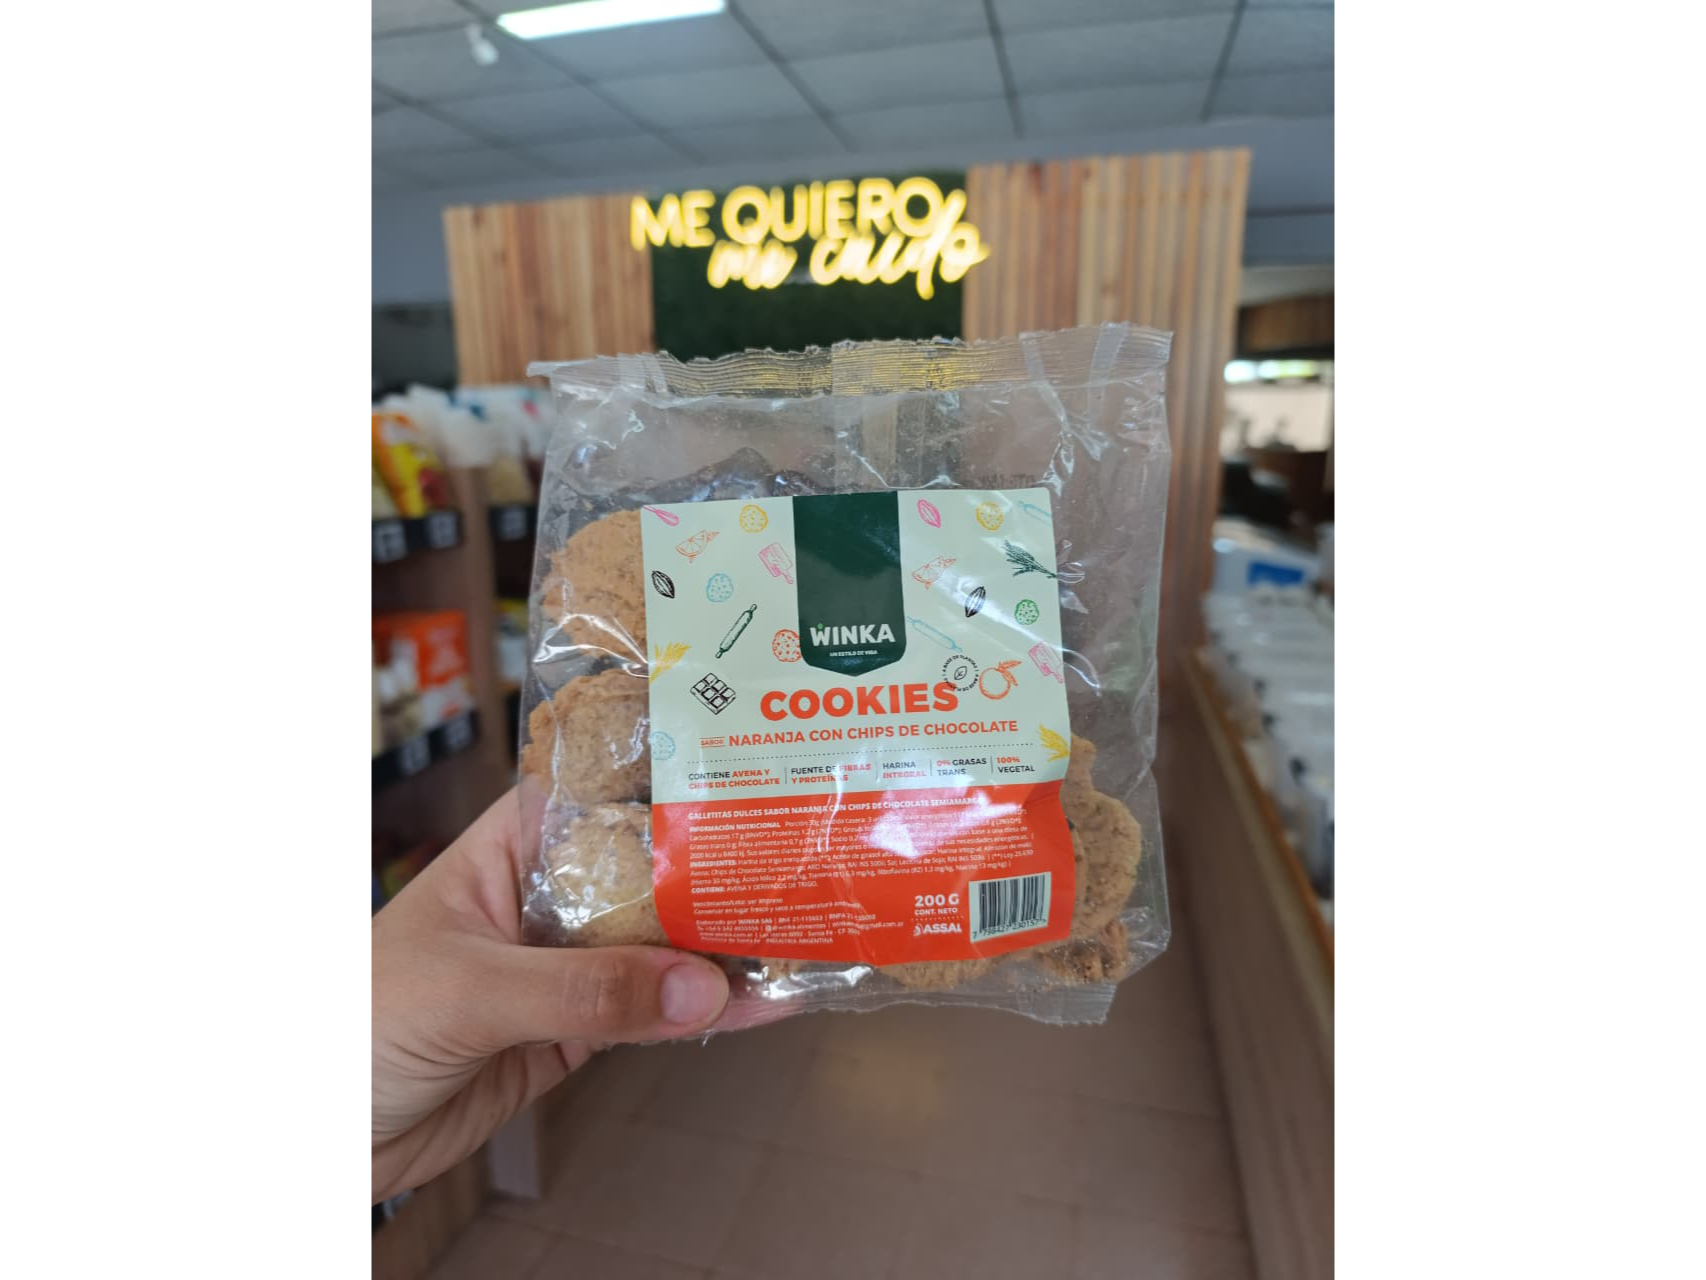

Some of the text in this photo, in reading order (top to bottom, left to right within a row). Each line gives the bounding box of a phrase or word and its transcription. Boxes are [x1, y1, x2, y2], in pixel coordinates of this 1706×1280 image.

[630, 177, 944, 252] ME QUIERO
[810, 624, 896, 646] WINKA
[760, 682, 959, 721] COOKIES
[729, 720, 1019, 746] NARANJA CON CHIPS DE CHOCOLATE
[937, 757, 987, 767] 0% GRASAS
[997, 756, 1021, 764] 100%
[689, 771, 731, 780] CONTIENE
[732, 770, 762, 778] AVENA
[791, 766, 823, 774] FUENTE
[883, 771, 927, 779] INTEGRAL
[937, 768, 966, 776] TRANS
[689, 782, 713, 790] CHIPS
[728, 778, 780, 787] CHOCOLATE
[689, 811, 731, 819] GALLETITAS
[733, 809, 762, 817] DULCES
[792, 805, 827, 814] NARANJA
[829, 802, 847, 812] CN
[848, 803, 870, 811] CHIPS
[883, 800, 929, 810] CHOCOLATE
[915, 893, 960, 907] 200 G
[923, 923, 962, 934] ASSAL
